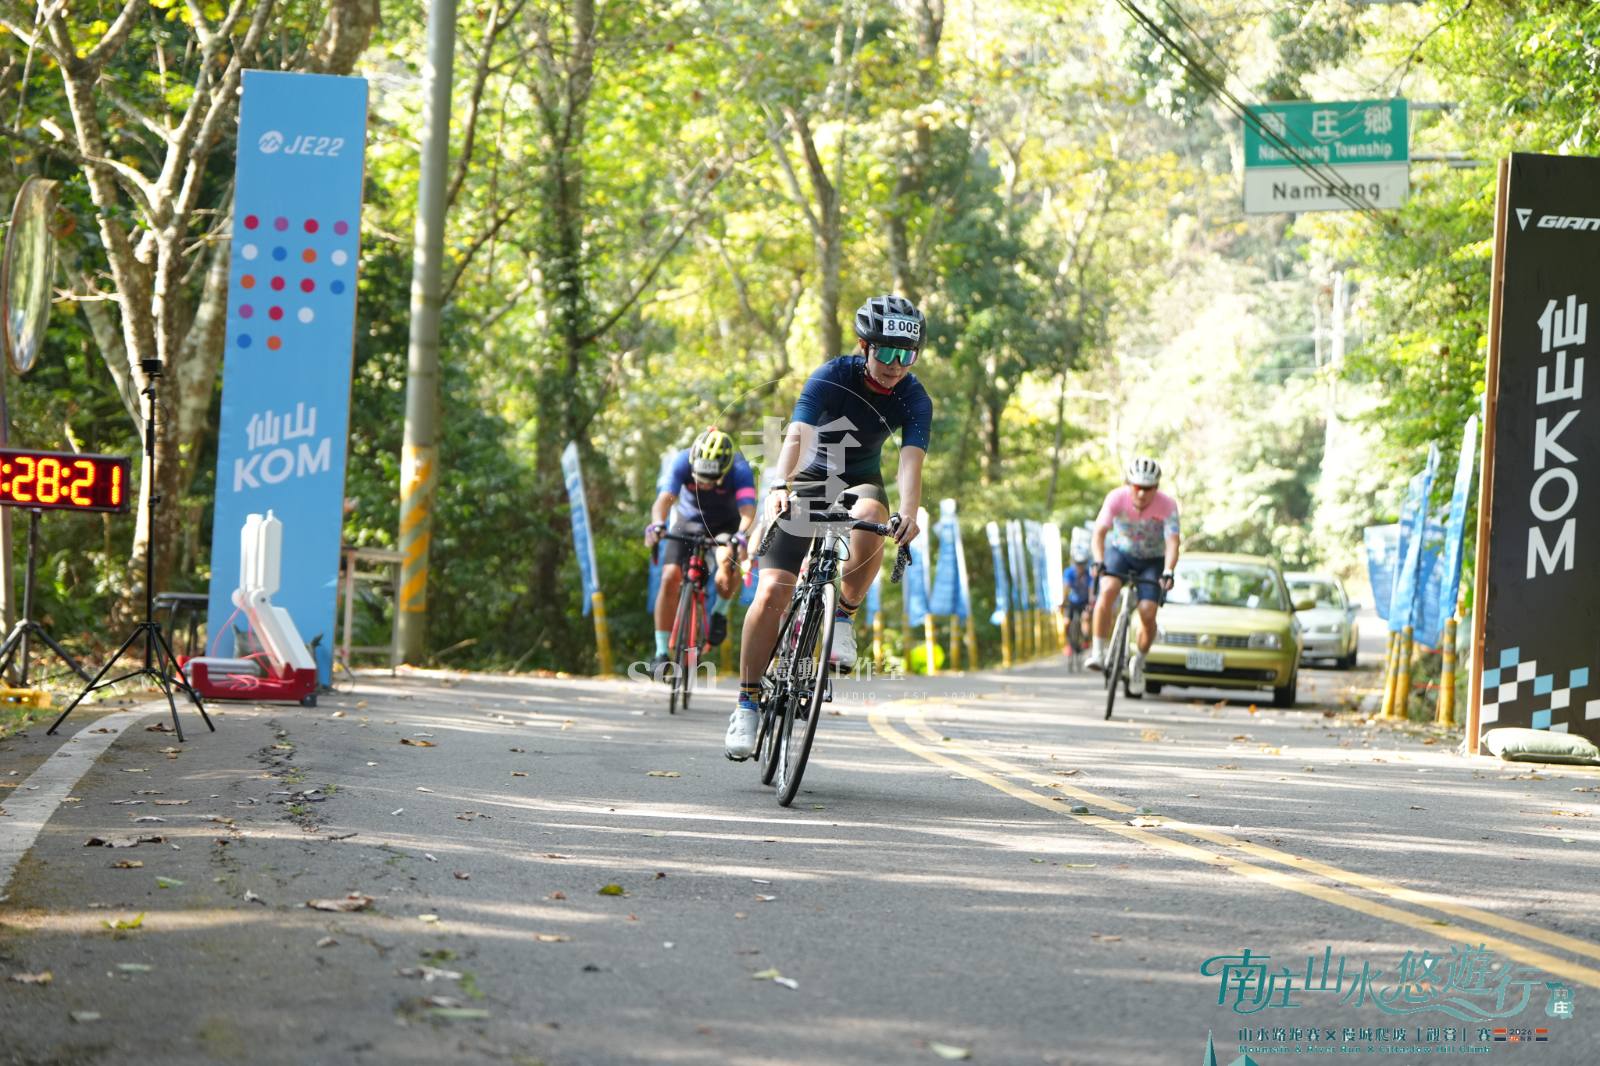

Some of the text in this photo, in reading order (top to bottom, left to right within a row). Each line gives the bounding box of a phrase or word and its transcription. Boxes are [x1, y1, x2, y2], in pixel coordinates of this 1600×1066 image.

[284, 135, 345, 157] JE22
[1334, 141, 1392, 158] Township
[1536, 214, 1600, 231] GIAN
[246, 402, 318, 450] 仙山
[0, 456, 121, 506] :28:21
[233, 437, 332, 492] KOM
